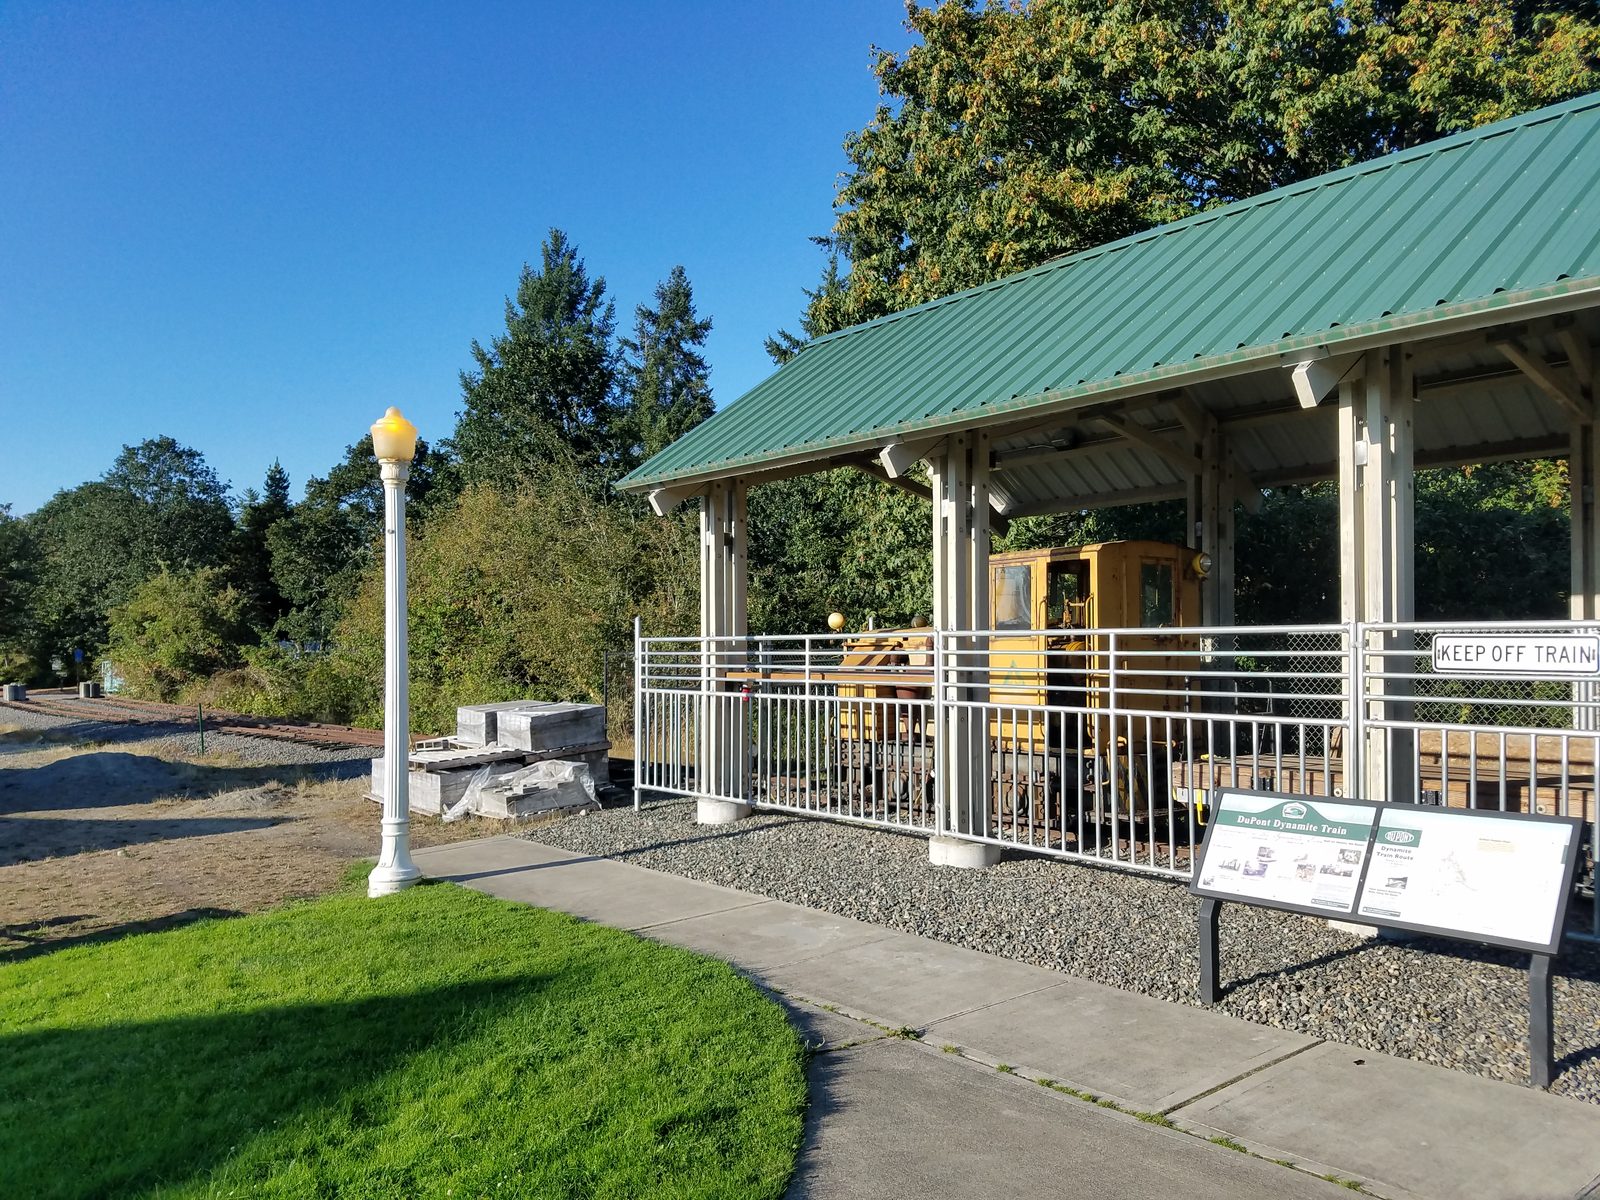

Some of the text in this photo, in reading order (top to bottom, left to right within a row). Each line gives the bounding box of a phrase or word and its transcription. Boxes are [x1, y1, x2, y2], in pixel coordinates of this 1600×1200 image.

[1441, 645, 1591, 664] KEEP OFF TRAIN
[1237, 815, 1347, 835] DuPont Dynamite Train
